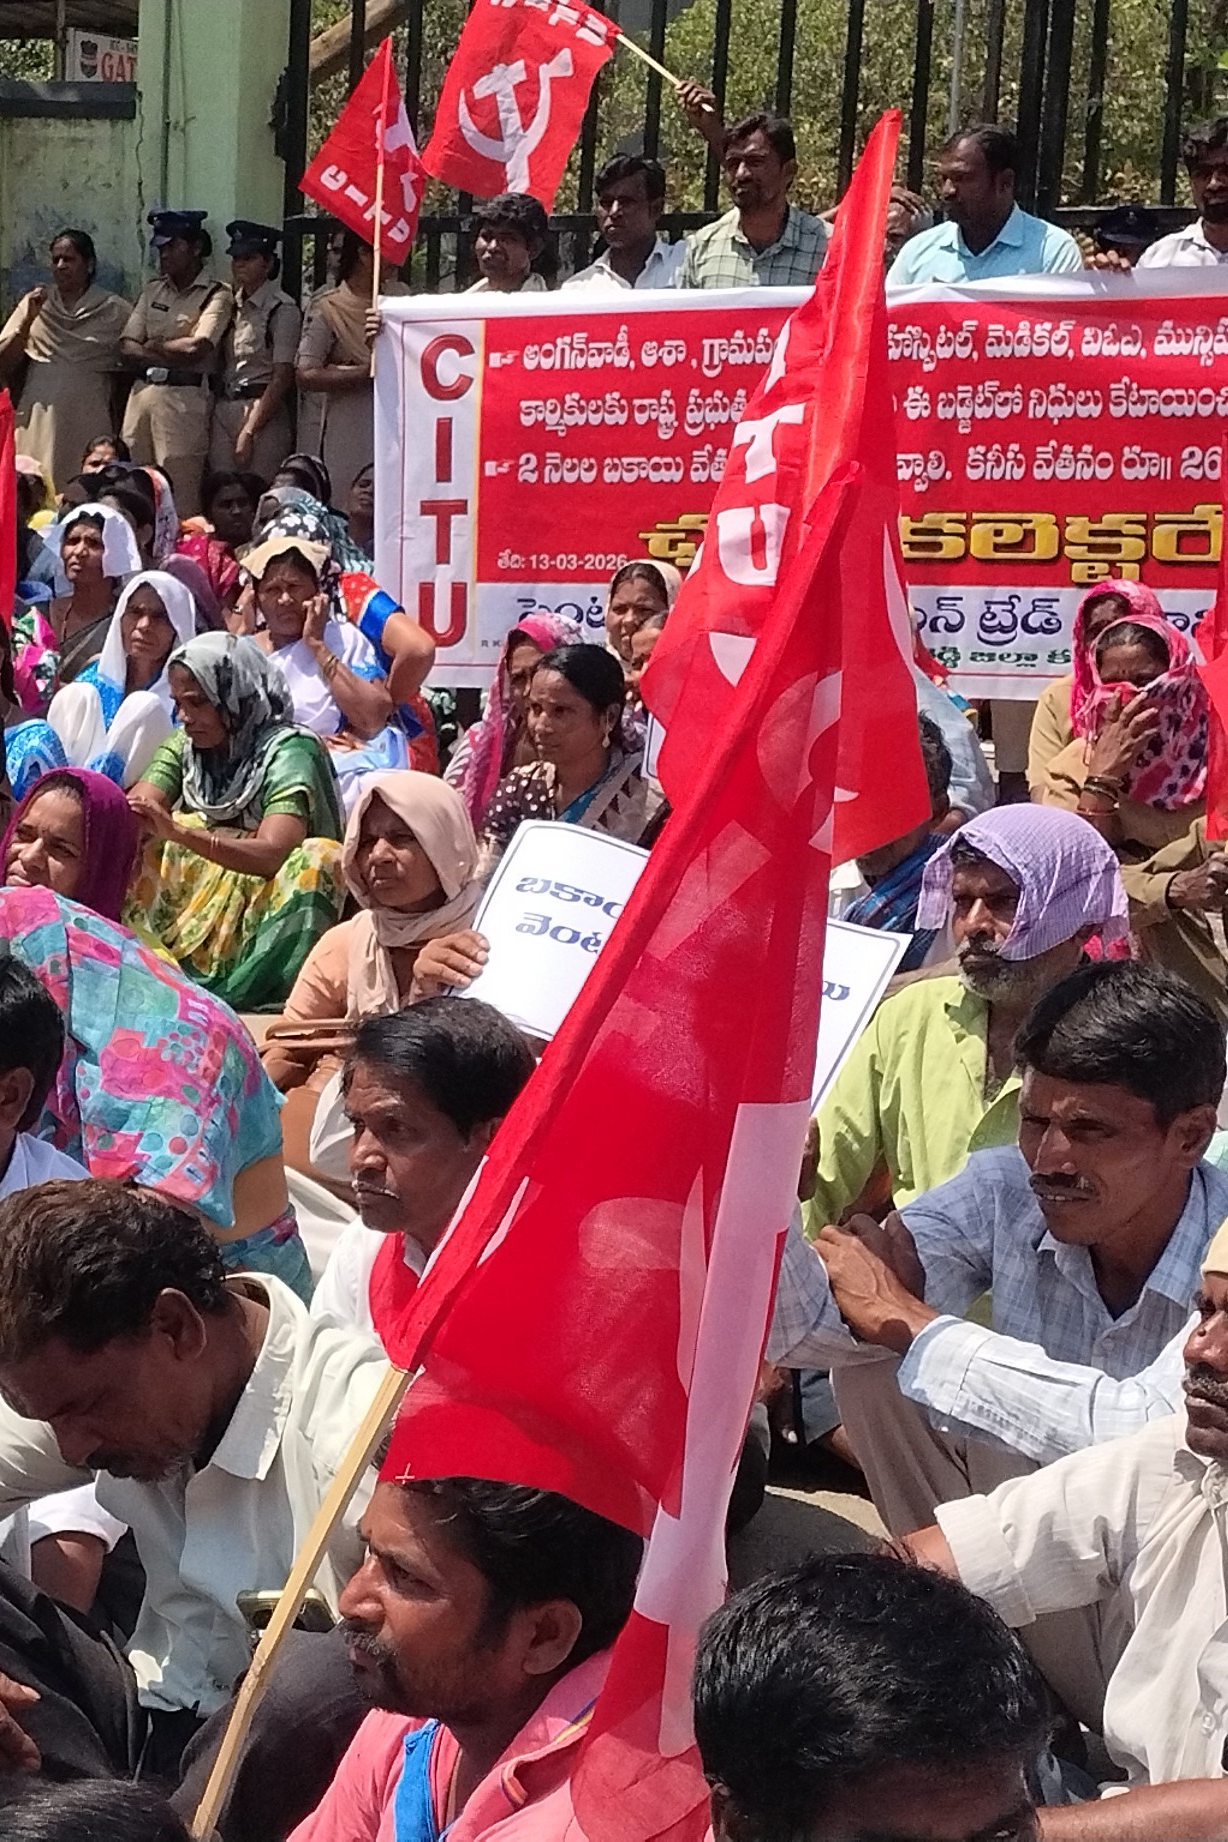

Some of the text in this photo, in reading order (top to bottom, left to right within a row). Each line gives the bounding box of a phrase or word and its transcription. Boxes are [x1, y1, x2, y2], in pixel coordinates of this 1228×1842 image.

[101, 52, 137, 82] GAT
[701, 327, 778, 378] గ్రామప
[1154, 317, 1228, 366] మున్సిప
[684, 386, 747, 437] ప్రభుత
[903, 385, 931, 420] ఈ
[1027, 382, 1103, 426] నిధులు
[518, 452, 539, 484] 2
[544, 451, 597, 484] నెలల
[689, 443, 728, 484] వేత
[965, 443, 1026, 481] కనీస
[1033, 439, 1114, 481] వేతనం
[1179, 445, 1222, 481] 26
[418, 333, 475, 648] CITU
[529, 553, 628, 571] 13-03-2026
[900, 503, 1223, 584] కలెక్టరే
